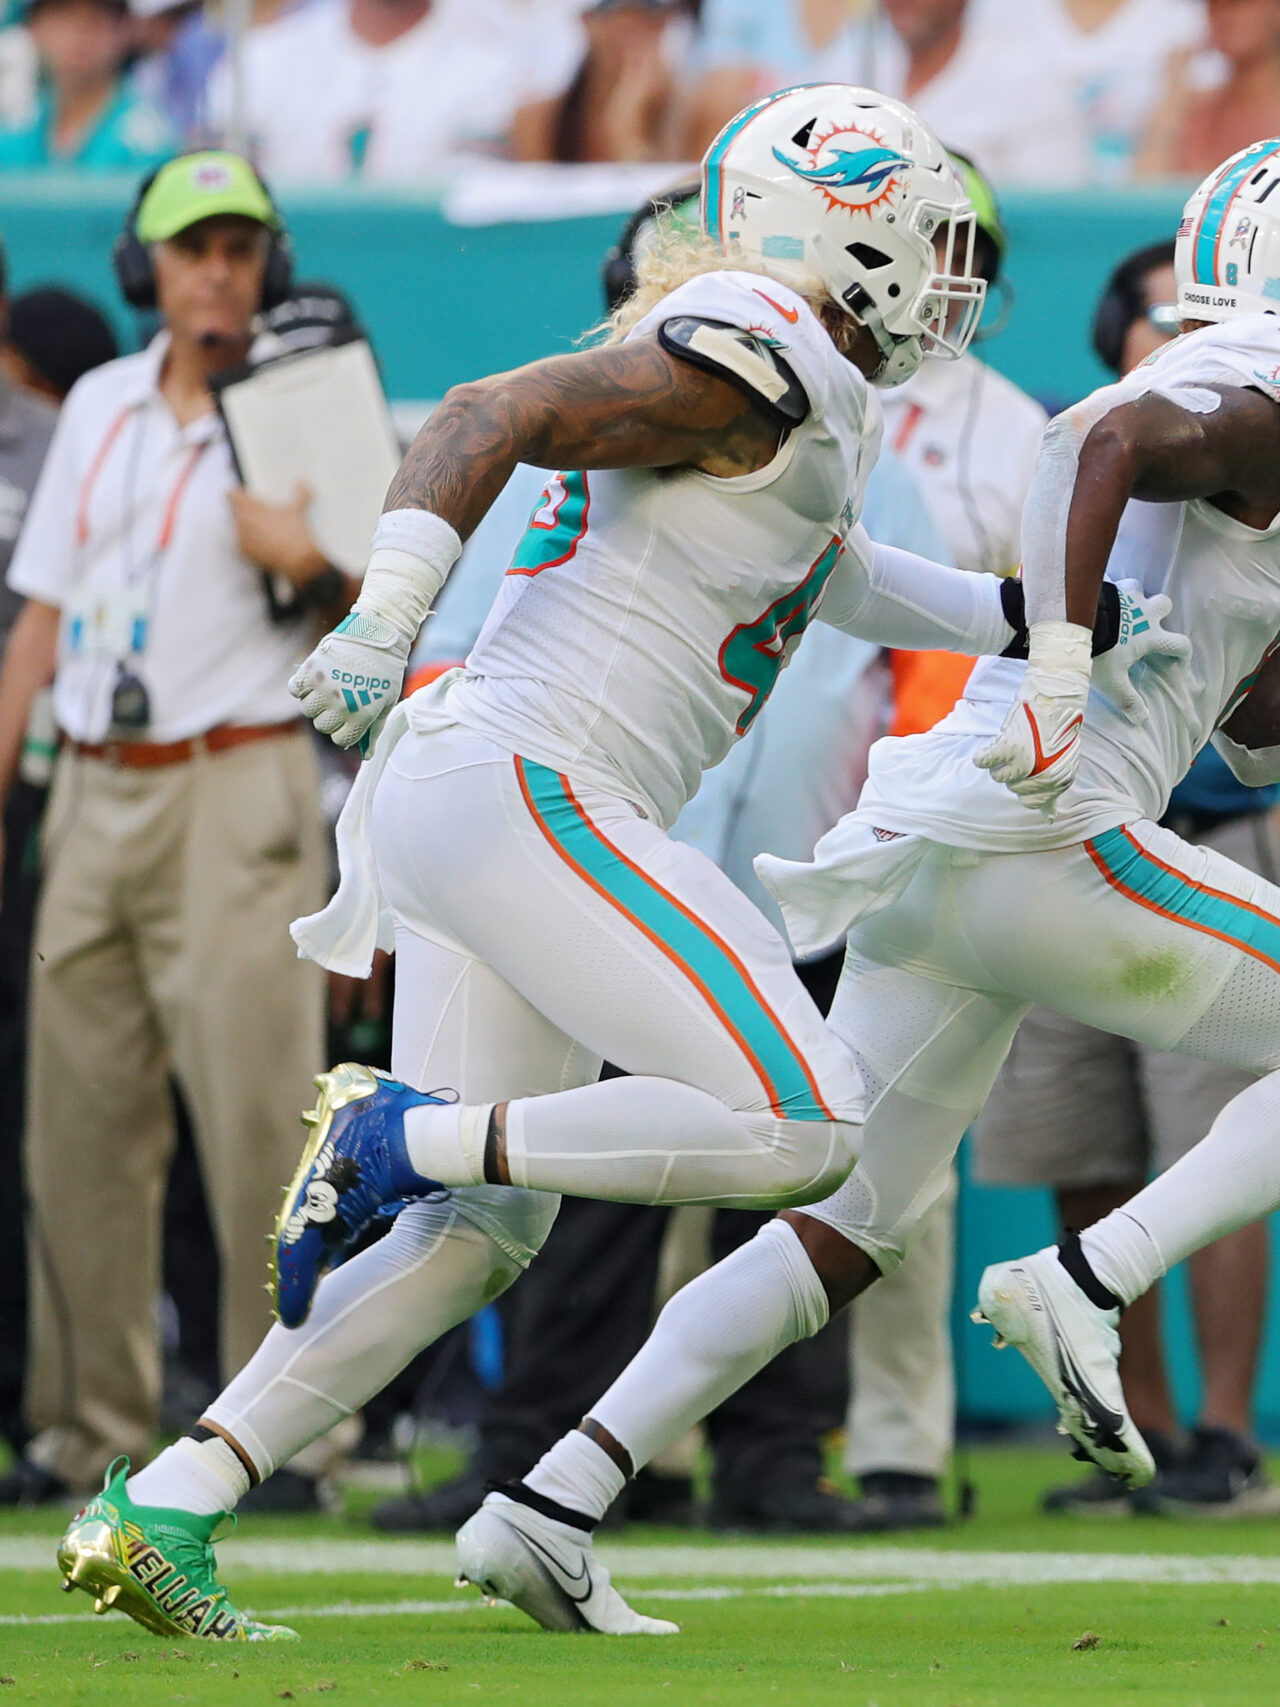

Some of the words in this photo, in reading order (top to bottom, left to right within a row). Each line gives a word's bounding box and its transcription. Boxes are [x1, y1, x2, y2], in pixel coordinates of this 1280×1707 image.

[1226, 262, 1238, 287] 8
[1184, 291, 1211, 306] CHOOSE
[1212, 297, 1237, 308] LOVE
[331, 668, 391, 691] adidas
[128, 1547, 238, 1640] ELIJAH
